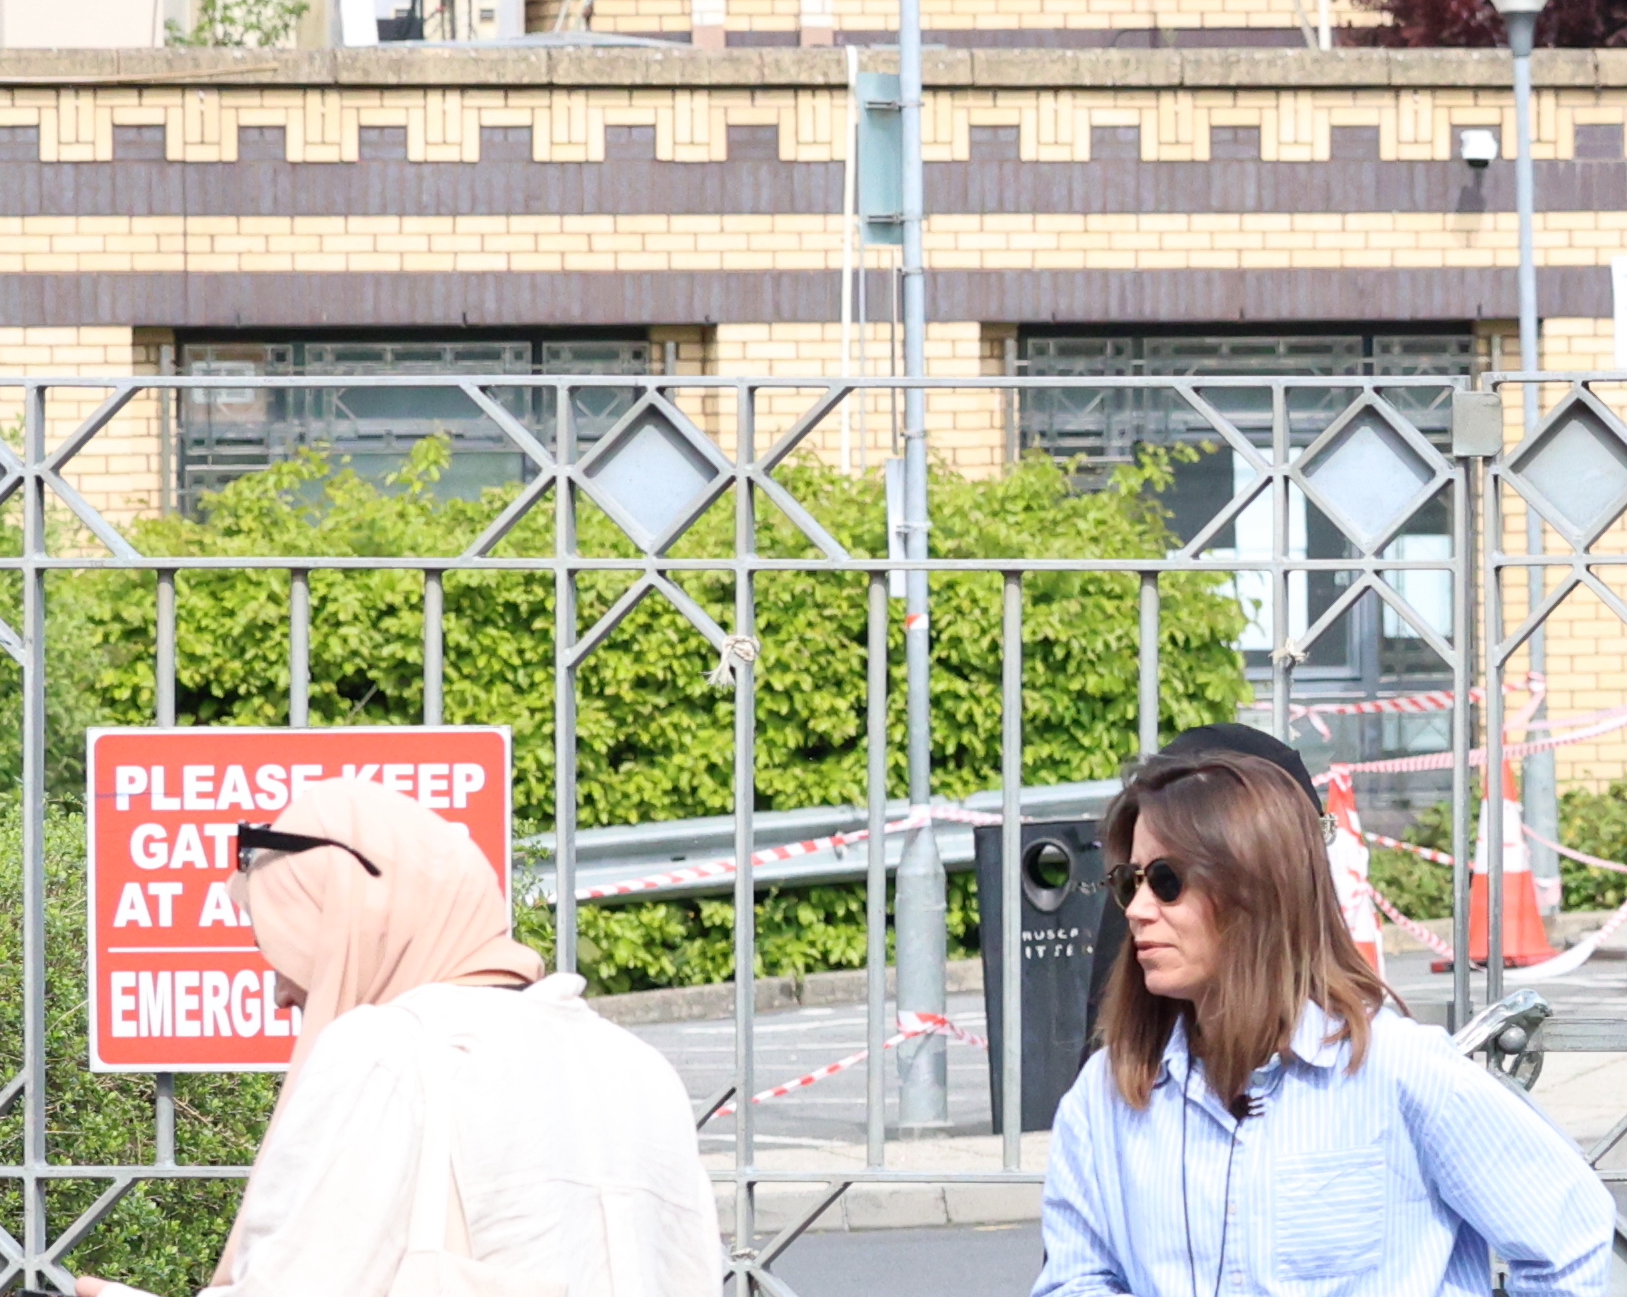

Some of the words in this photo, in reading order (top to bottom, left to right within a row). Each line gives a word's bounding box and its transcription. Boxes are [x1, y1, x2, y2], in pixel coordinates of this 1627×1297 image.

[130, 822, 240, 871] GAT
[112, 881, 183, 928] AT
[110, 969, 301, 1038] EMERGE
